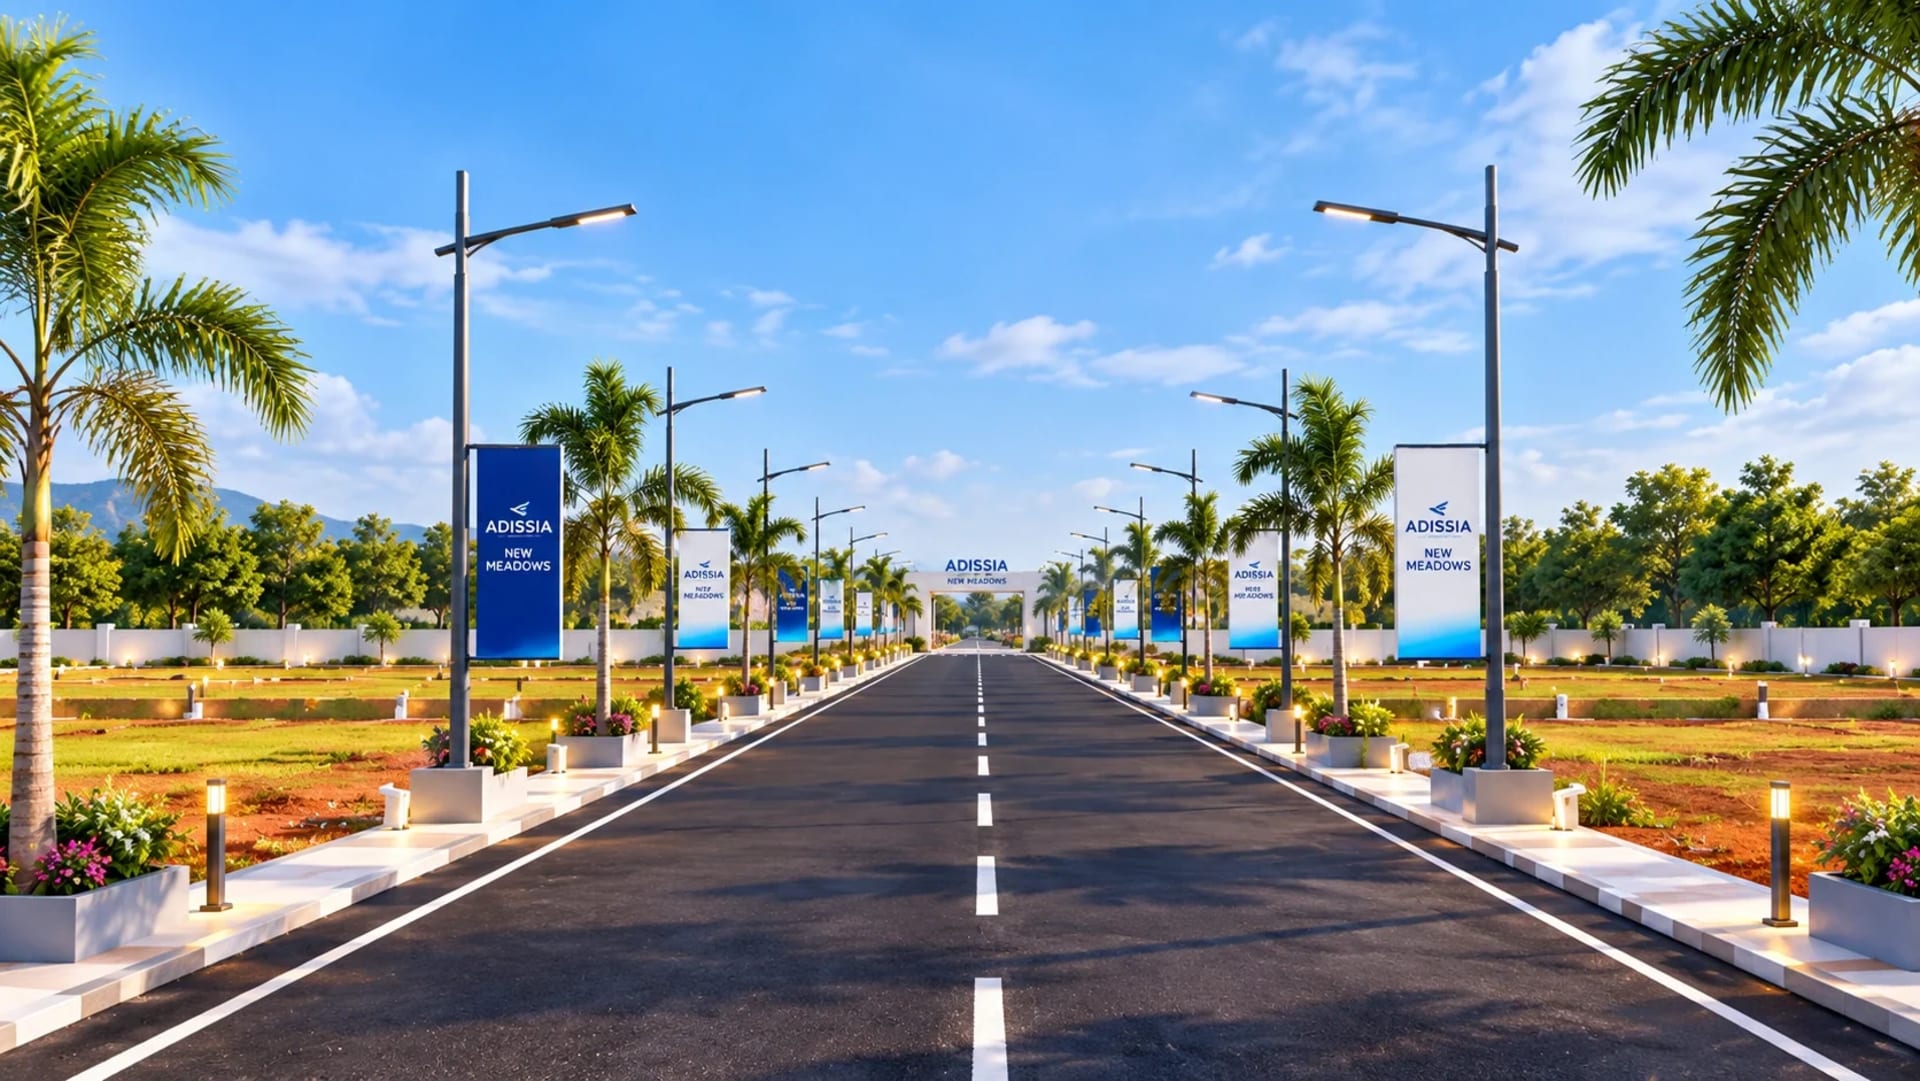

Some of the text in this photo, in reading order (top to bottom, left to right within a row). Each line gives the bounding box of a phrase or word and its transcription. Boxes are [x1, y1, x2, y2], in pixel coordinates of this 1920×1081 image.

[485, 520, 553, 534] ADISSIA
[1405, 520, 1472, 533] ADISSIA
[504, 548, 533, 559] NEW
[1424, 548, 1453, 559] NEW
[485, 560, 551, 572] MEADOWS
[945, 559, 1009, 572] ADISSIA
[1406, 560, 1472, 571] MEADOWS
[684, 570, 724, 579] ADISSIA
[1234, 570, 1274, 579] ADISSIA
